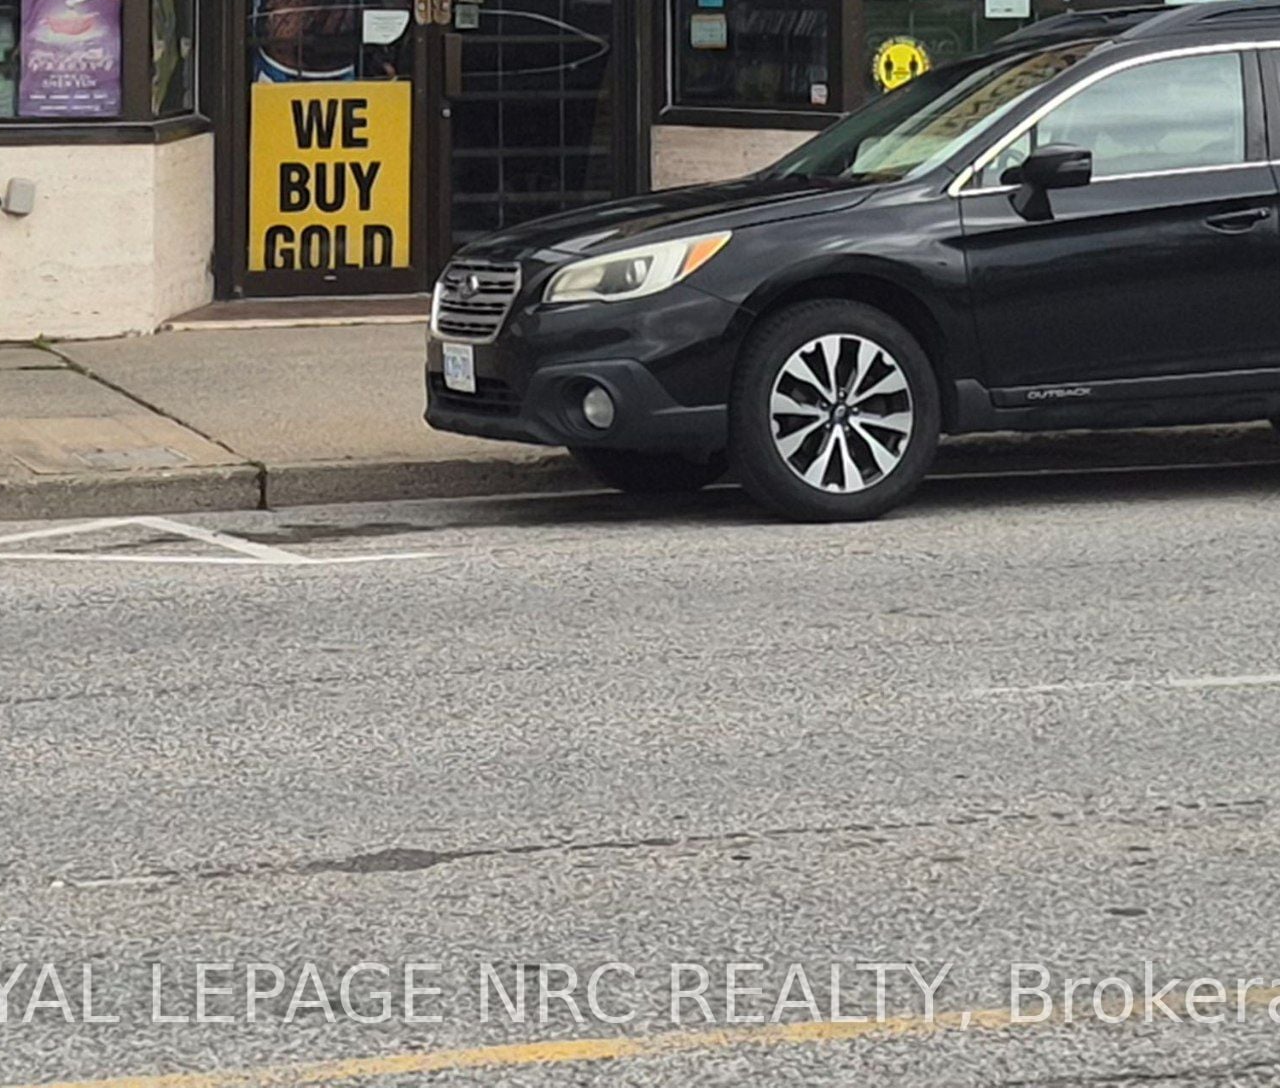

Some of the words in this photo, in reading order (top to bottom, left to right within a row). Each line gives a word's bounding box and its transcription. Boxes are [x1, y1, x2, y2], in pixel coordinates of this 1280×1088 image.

[291, 99, 368, 148] WE
[279, 162, 381, 213] BUY
[264, 224, 394, 270] GOLD
